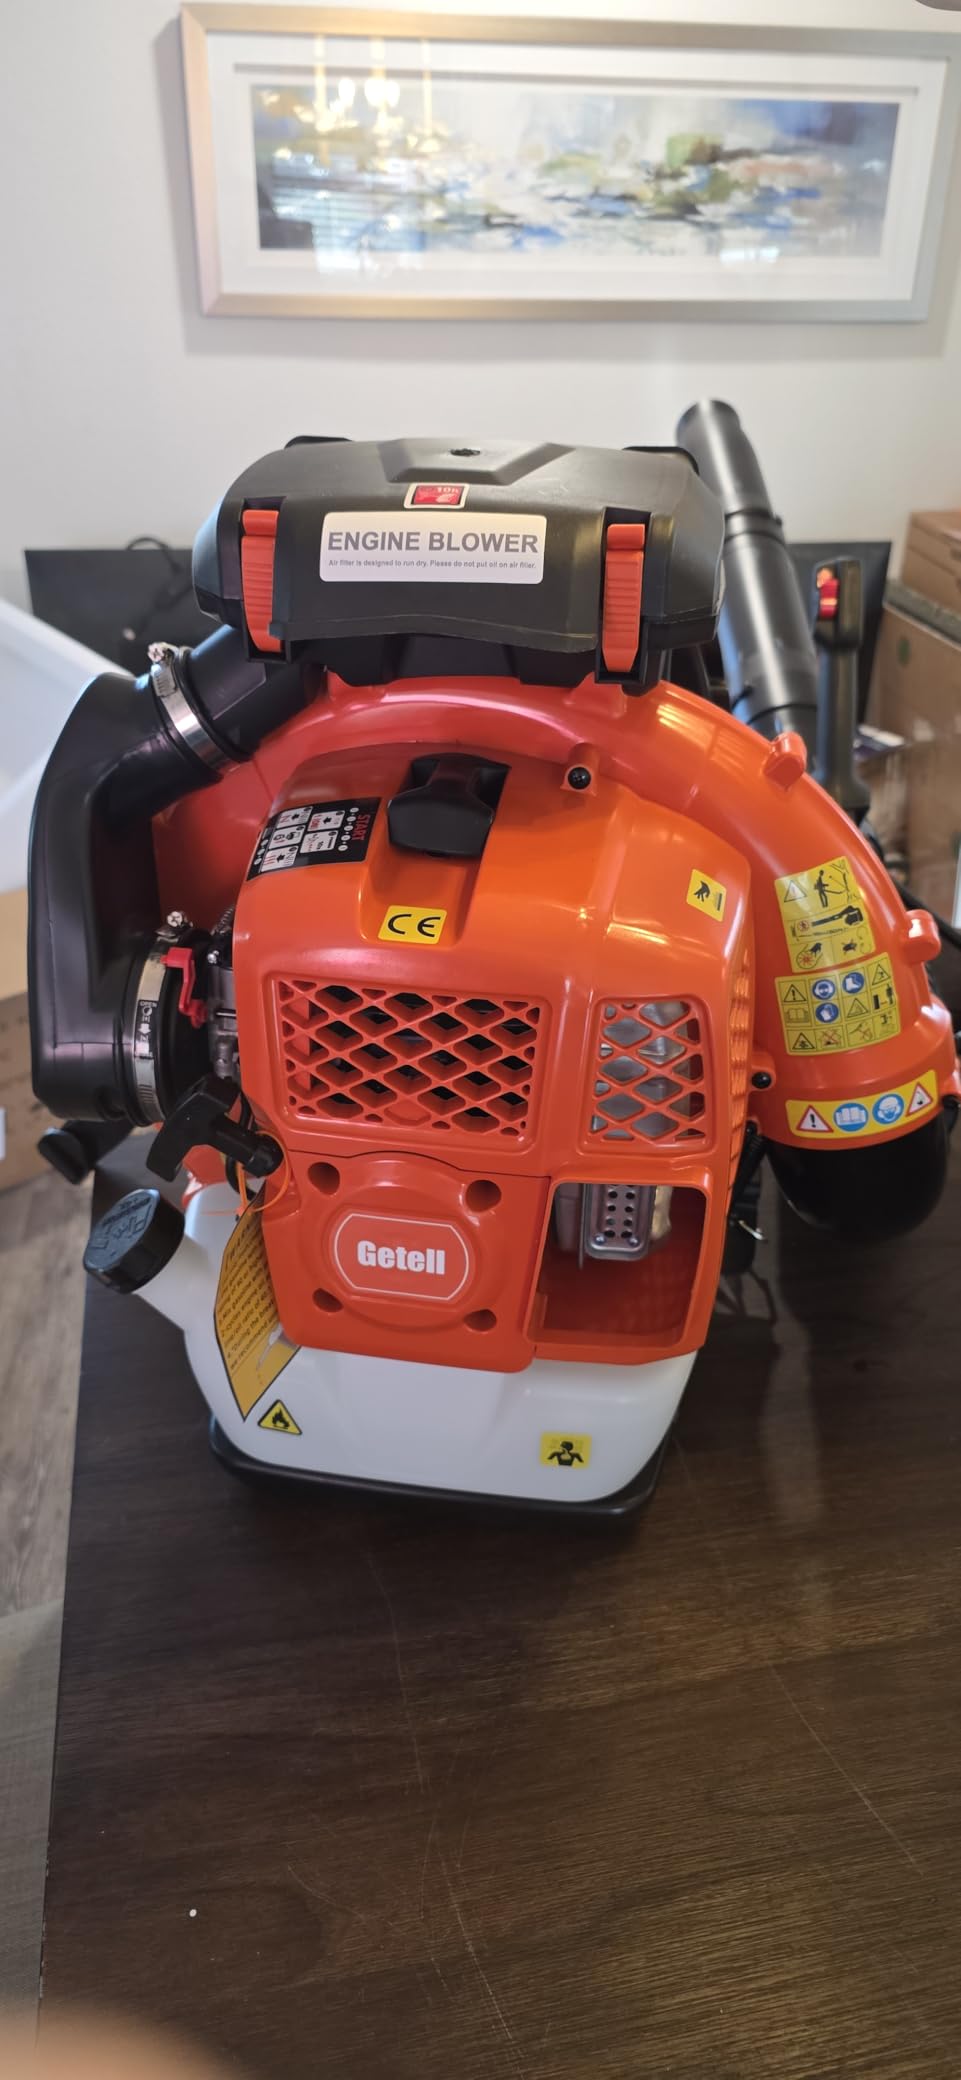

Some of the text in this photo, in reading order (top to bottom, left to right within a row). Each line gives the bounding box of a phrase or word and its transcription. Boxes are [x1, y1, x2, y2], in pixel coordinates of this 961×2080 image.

[327, 531, 539, 553] ENGINE BLOWER
[363, 559, 394, 568] designed
[415, 559, 429, 568] dry.
[429, 559, 452, 567] Please
[453, 559, 462, 567] do
[476, 560, 488, 568] put
[509, 561, 519, 569] air
[351, 814, 371, 841] START
[387, 913, 442, 938] CE
[357, 1240, 446, 1275] Getell
